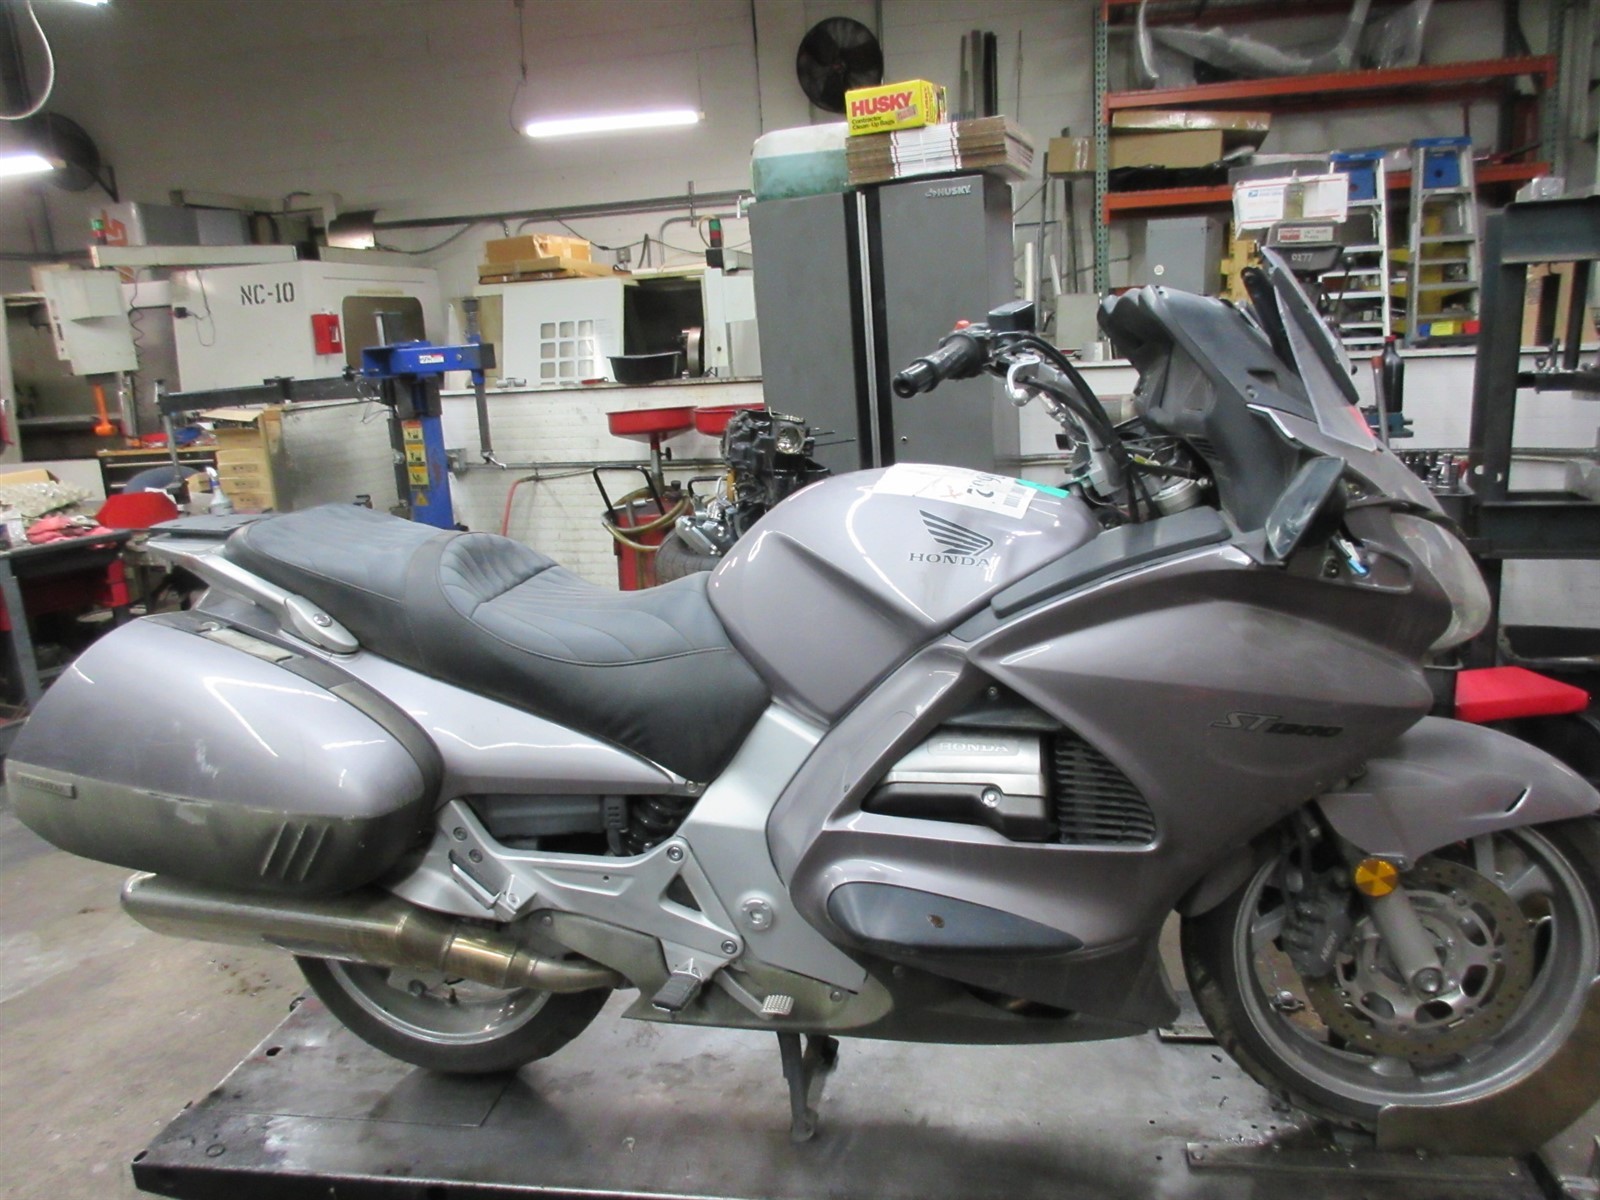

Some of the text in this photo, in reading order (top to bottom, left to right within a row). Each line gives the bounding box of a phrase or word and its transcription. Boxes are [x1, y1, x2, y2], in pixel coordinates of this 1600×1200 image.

[851, 91, 912, 117] HUSKY
[852, 116, 881, 124] Contractor
[937, 185, 971, 196] HUSKY
[240, 282, 295, 305] NC-10
[909, 553, 990, 567] HONDA
[939, 743, 1009, 752] HONDA
